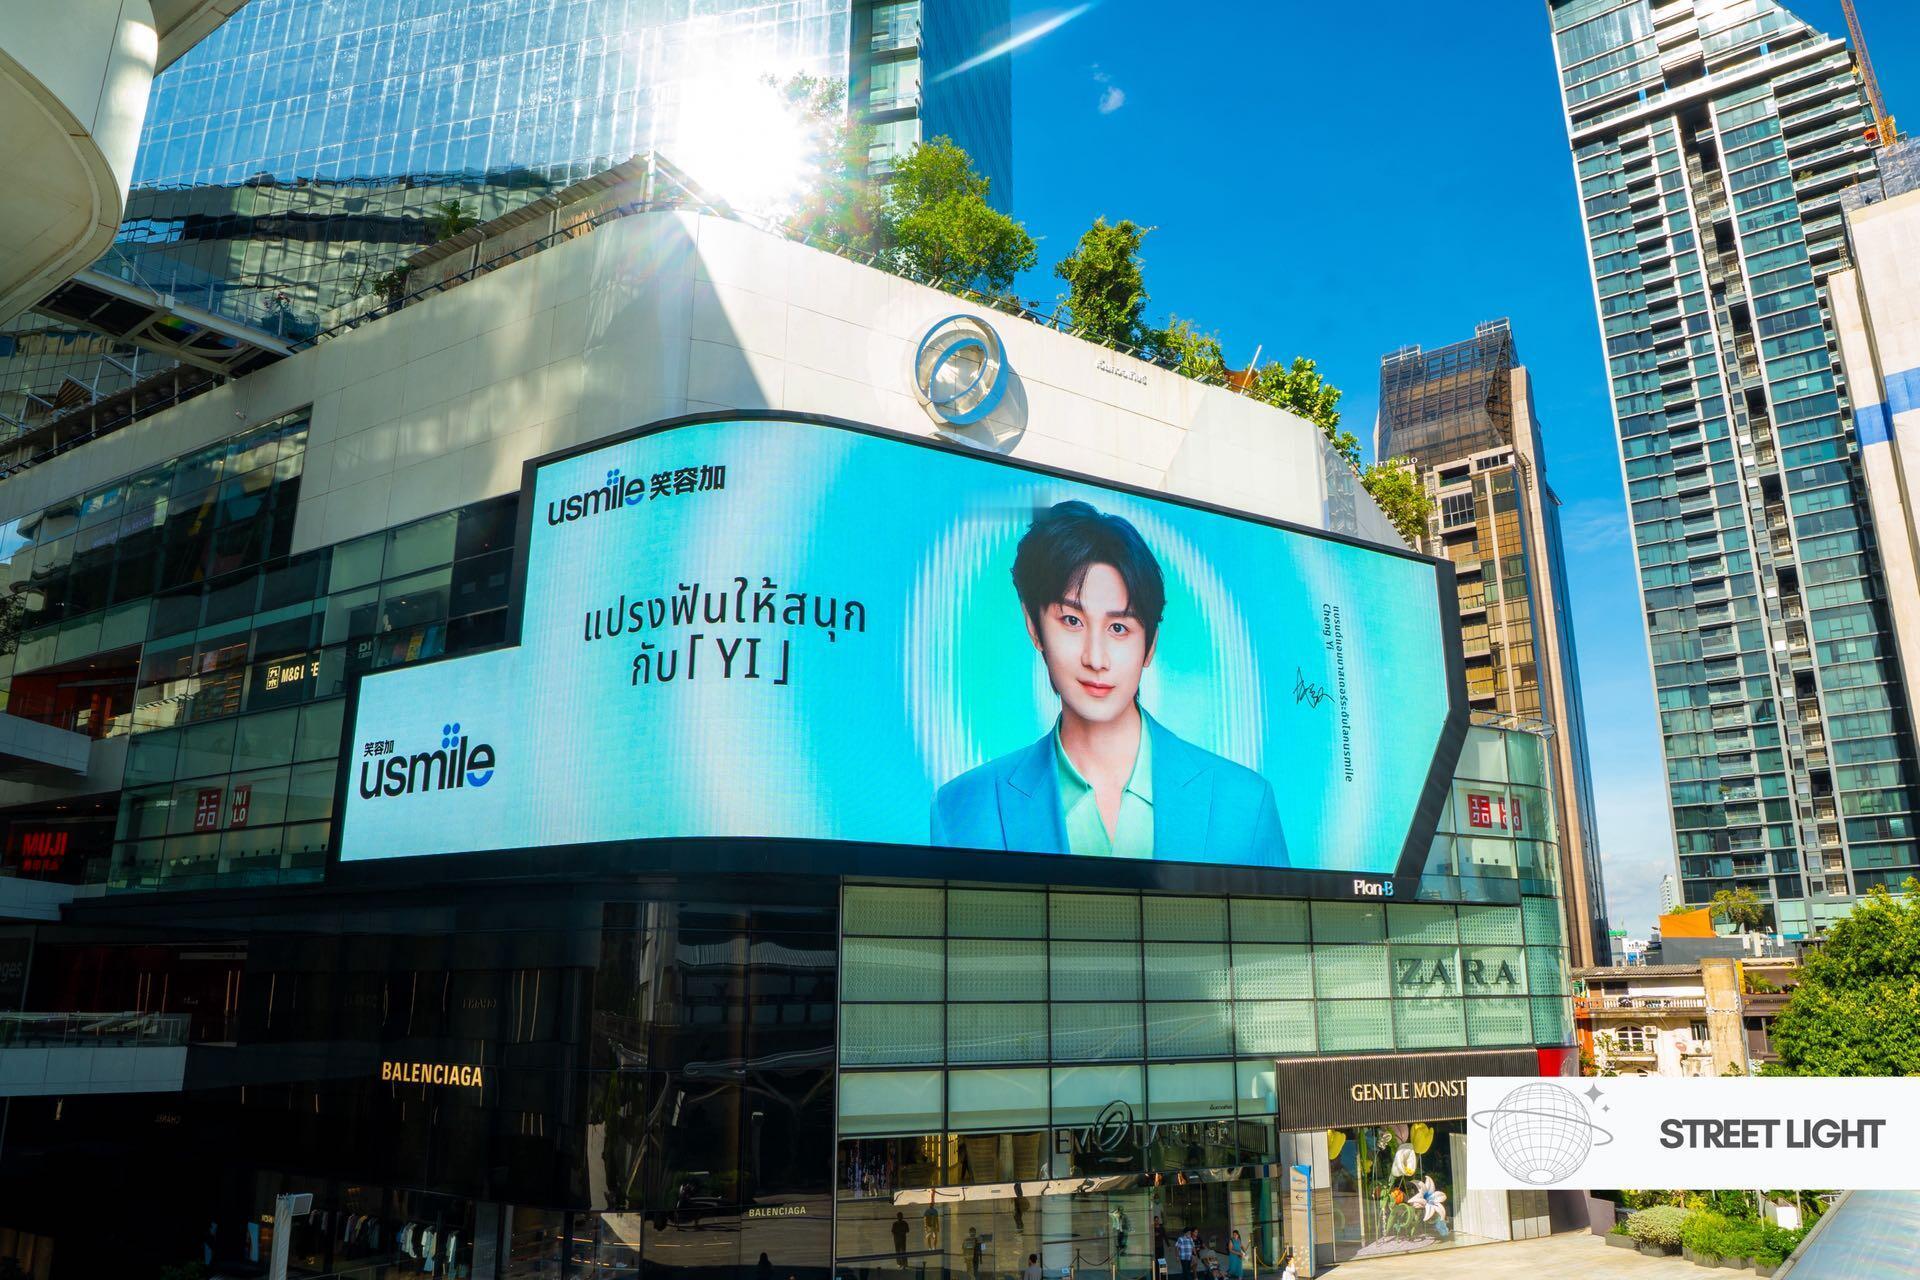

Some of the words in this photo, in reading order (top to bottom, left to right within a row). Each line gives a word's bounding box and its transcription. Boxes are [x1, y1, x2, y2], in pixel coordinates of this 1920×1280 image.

[649, 464, 726, 501] 笑容加
[548, 469, 645, 526] usmile
[584, 576, 866, 643] แปรงฟันให้สนุก
[1322, 603, 1332, 637] Cheng
[359, 722, 496, 801] usmile
[363, 739, 395, 757] 笑容加
[23, 832, 68, 857] MUJI
[1398, 958, 1520, 985] ZARA
[382, 1061, 483, 1088] BALENCIAGA
[1351, 1082, 1410, 1102] GENTLE
[748, 1206, 806, 1217] BALENCIAGA
